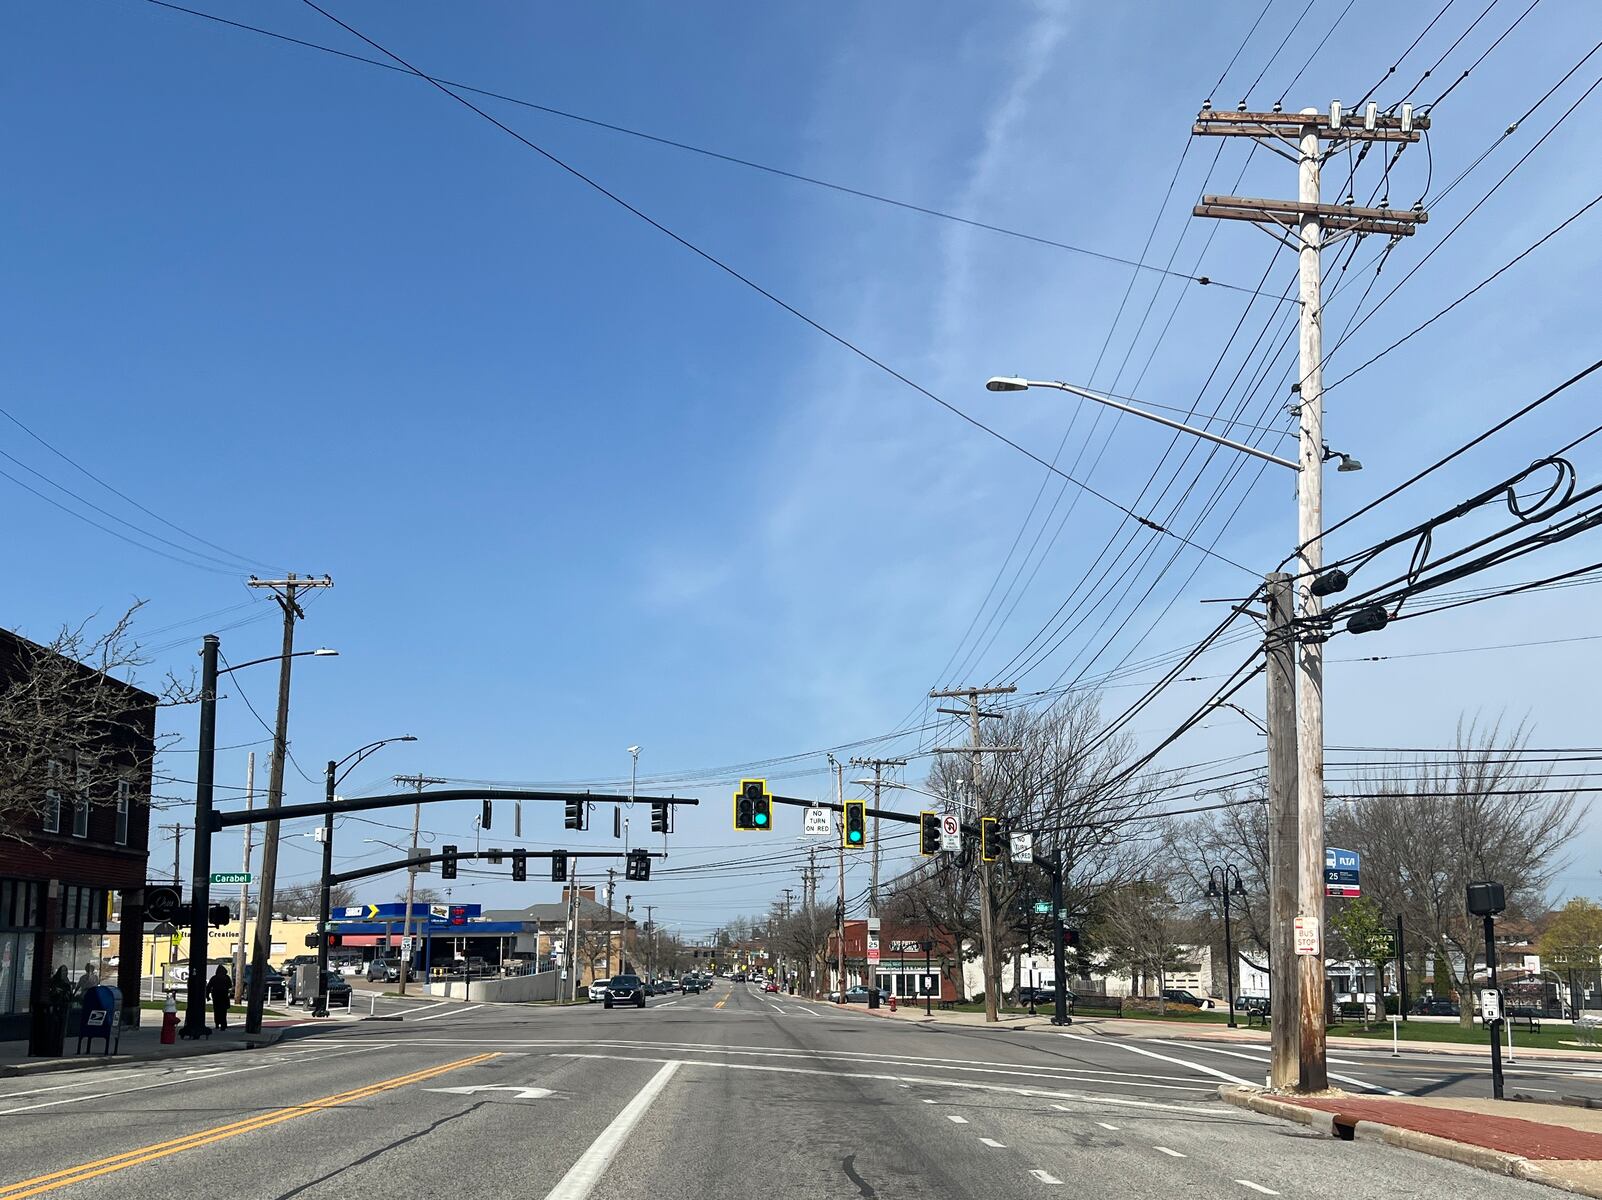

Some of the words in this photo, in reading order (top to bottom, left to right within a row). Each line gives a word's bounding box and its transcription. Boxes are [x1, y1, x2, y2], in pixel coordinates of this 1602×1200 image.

[1340, 858, 1355, 866] RTA
[215, 874, 247, 883] Carabel
[1328, 872, 1339, 880] 25
[1299, 929, 1314, 937] BUS
[1297, 938, 1316, 946] STOP
